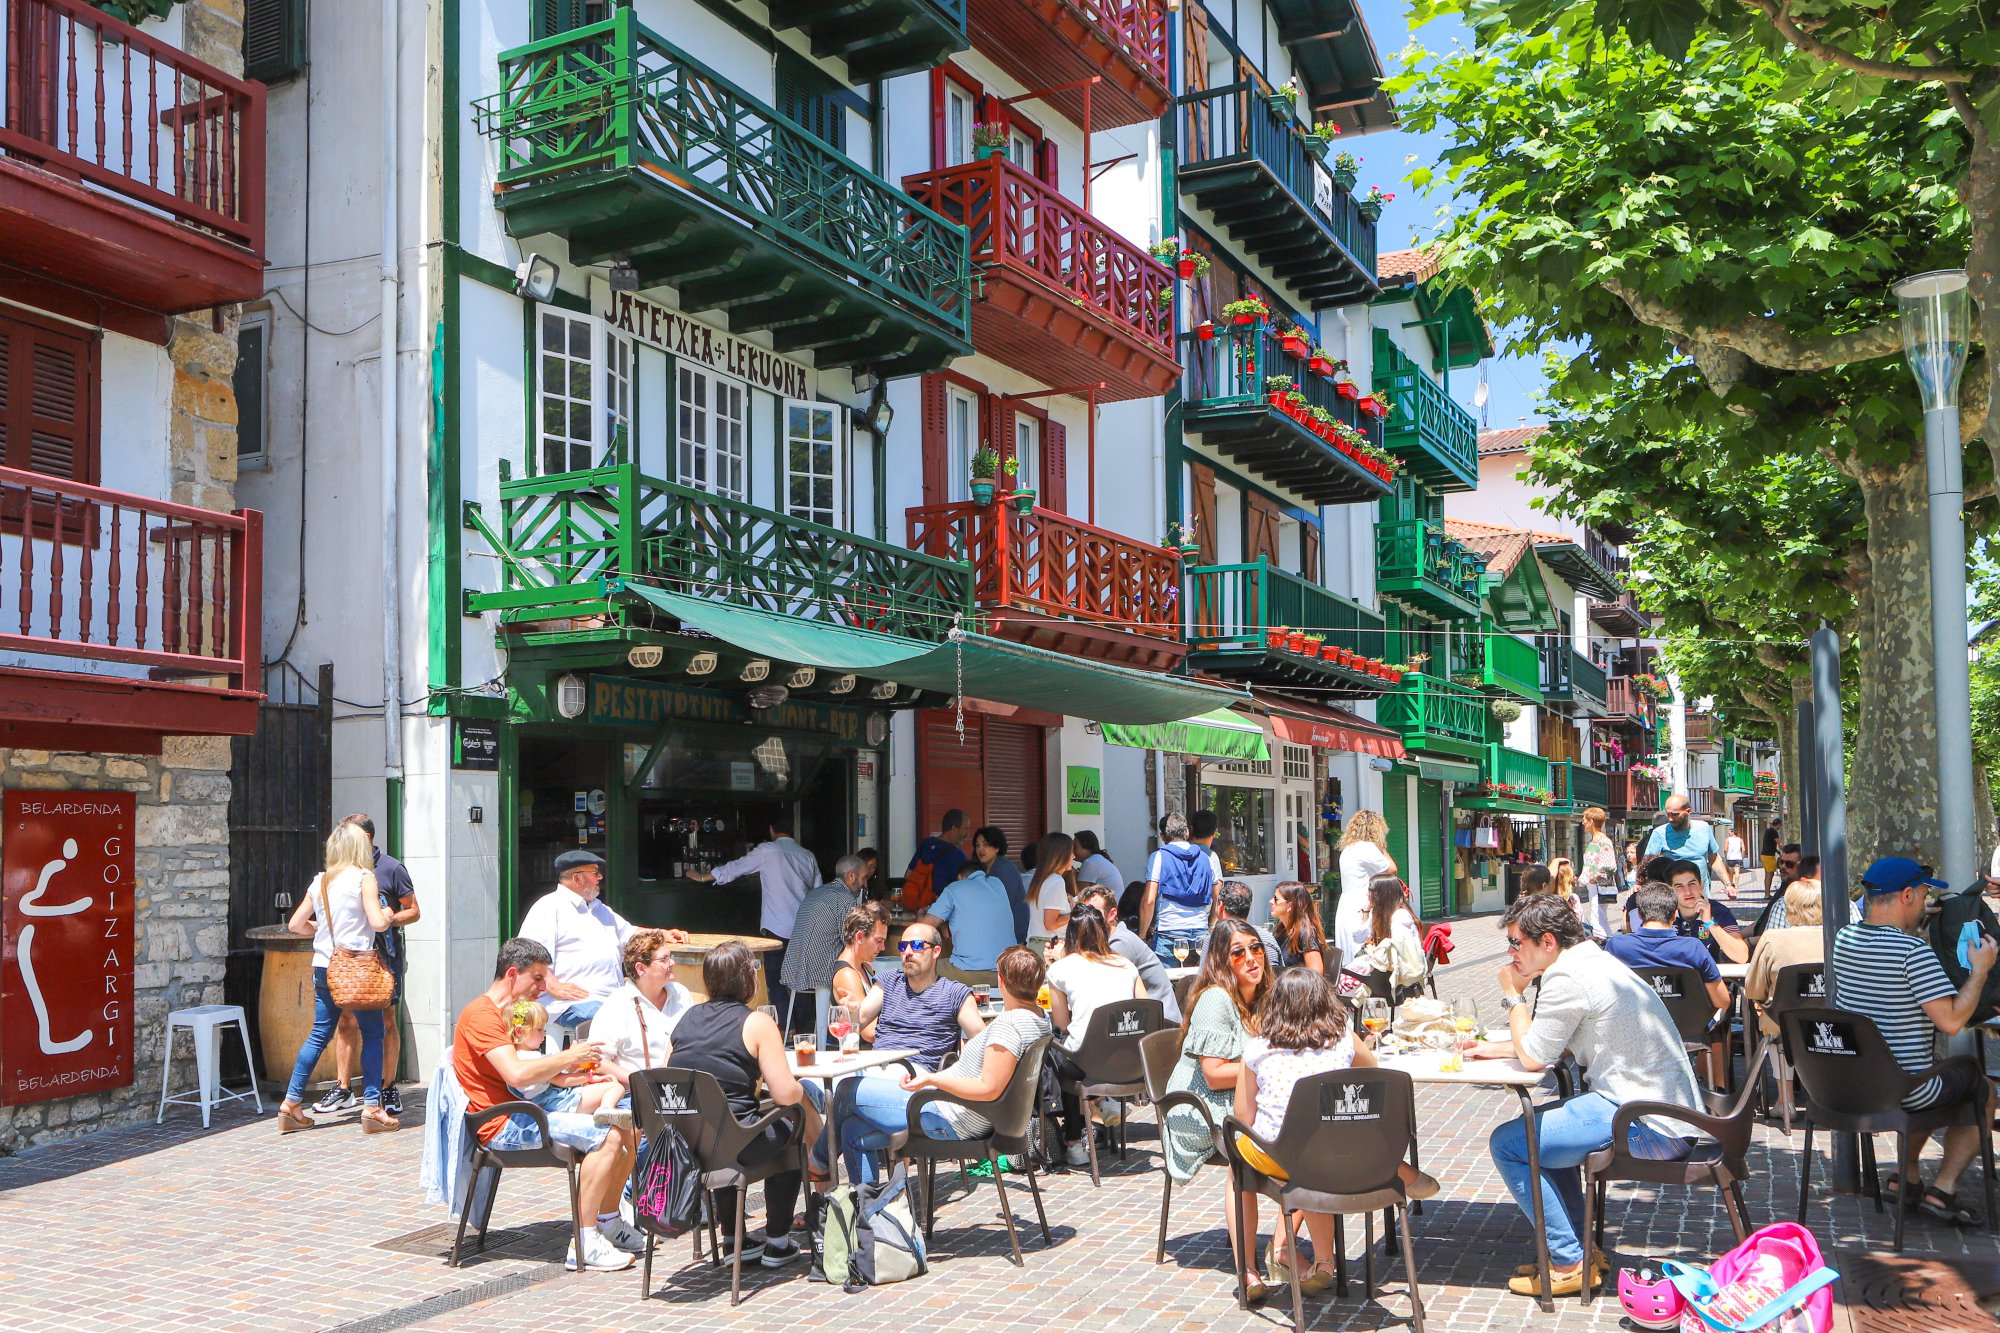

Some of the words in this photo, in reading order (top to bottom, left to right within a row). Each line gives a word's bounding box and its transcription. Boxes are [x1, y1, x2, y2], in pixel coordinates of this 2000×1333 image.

[604, 289, 715, 366] JATETXEA
[727, 337, 808, 400] LEKUONA
[21, 802, 121, 815] BELARDENDA
[103, 837, 121, 1046] GOIZARGI
[1814, 1036, 1843, 1048] LKN
[18, 1065, 120, 1091] BELARDENDA
[1336, 1099, 1368, 1113] LKN
